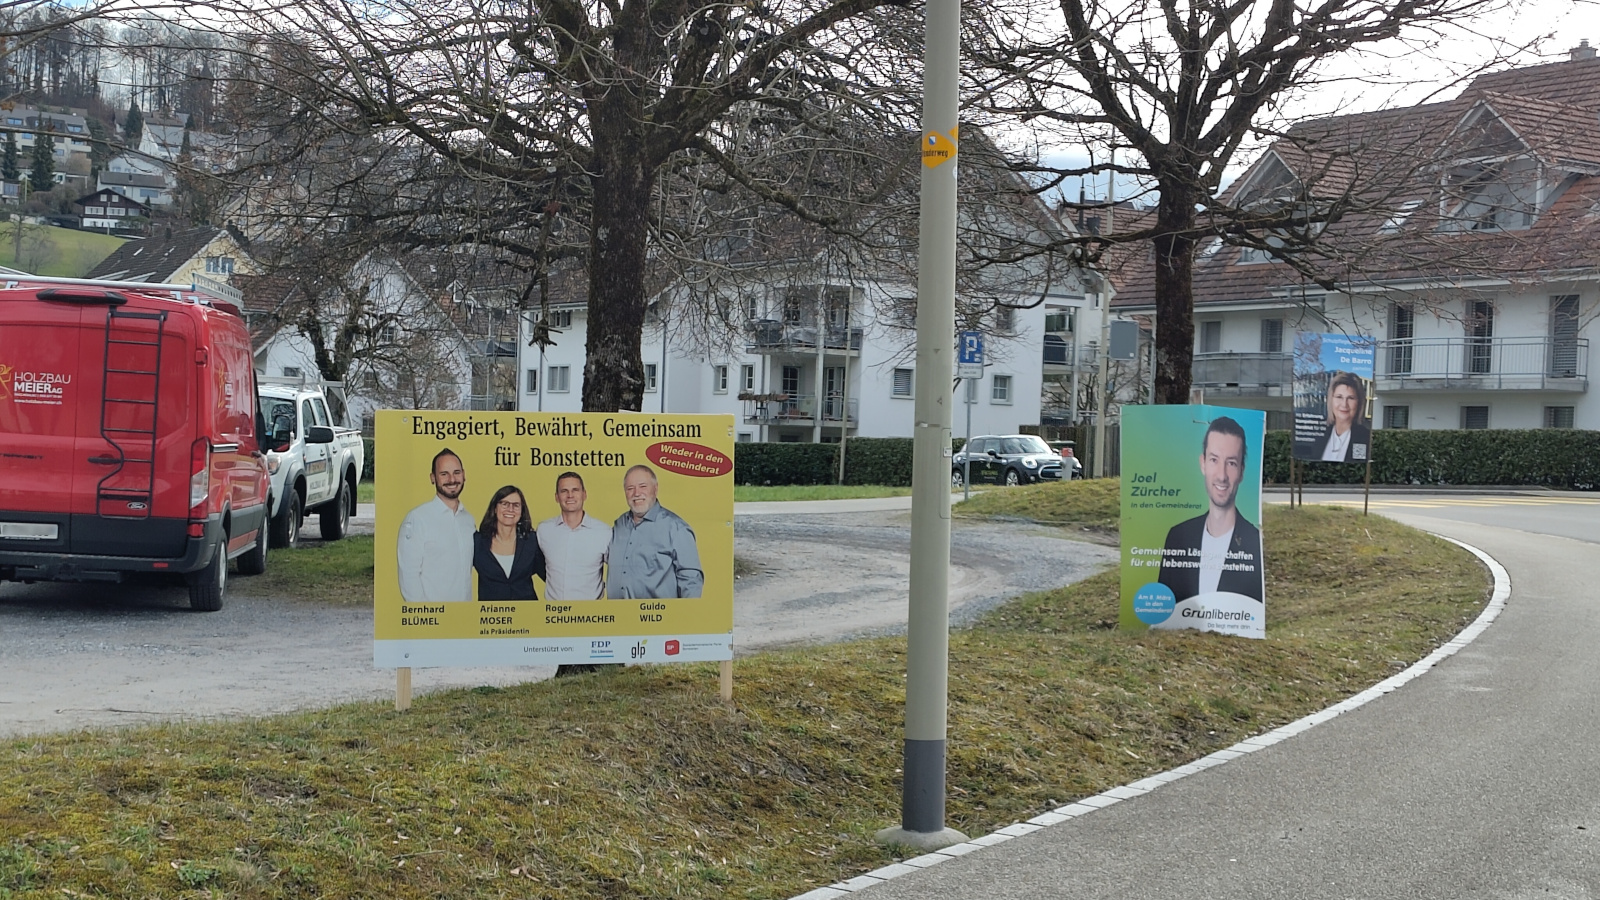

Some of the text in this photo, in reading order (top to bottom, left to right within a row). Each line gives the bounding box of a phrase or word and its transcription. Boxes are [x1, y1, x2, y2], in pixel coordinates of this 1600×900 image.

[965, 336, 978, 360] P
[1340, 356, 1372, 365] De Barro
[14, 371, 71, 384] HOLZBAU
[412, 415, 702, 440] Engagiert, Bewährt, Gemeinsam
[494, 446, 625, 467] für Bonstetten
[660, 444, 723, 464] Wieder in den
[659, 456, 720, 475] Gemeinderat
[1131, 471, 1157, 483] Joel
[1130, 485, 1181, 497] Zürcher
[1155, 502, 1202, 510] Gemeinderat
[1130, 546, 1186, 556] Gemeinsam
[1223, 550, 1254, 561] chaffen
[1130, 558, 1144, 567] für
[1146, 560, 1161, 568] ein
[401, 604, 445, 614] Bernhard
[480, 605, 516, 613] Arianne
[545, 604, 572, 613] Roger
[640, 602, 666, 611] Guido
[401, 616, 440, 626] BLÜMEL
[480, 617, 513, 625] MOSER
[545, 615, 615, 624] SCHUHMACHER
[640, 614, 663, 623] WILD
[523, 645, 559, 653] Unterstützt
[591, 640, 612, 648] FDP
[631, 641, 646, 659] glp
